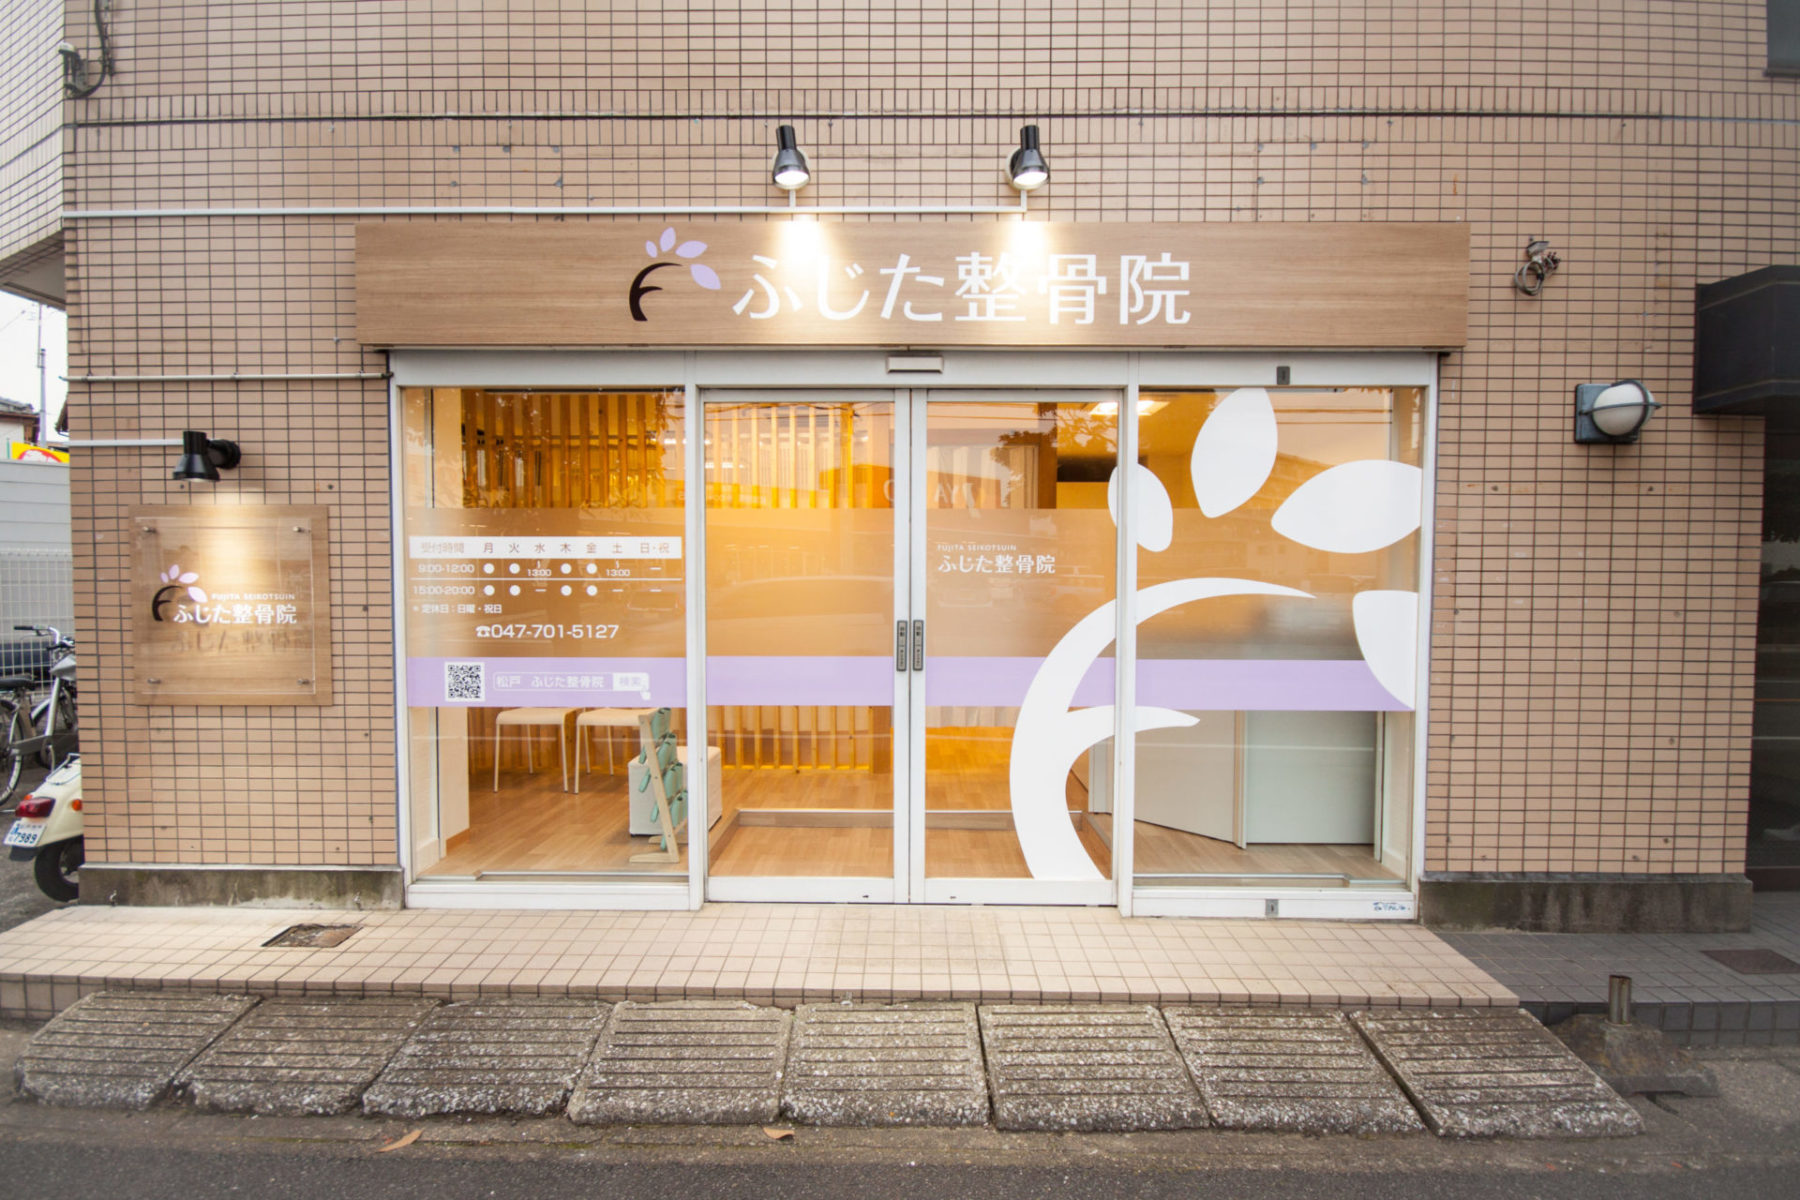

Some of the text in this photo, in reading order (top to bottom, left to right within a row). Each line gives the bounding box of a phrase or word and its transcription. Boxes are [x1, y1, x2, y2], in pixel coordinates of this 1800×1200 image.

[733, 252, 1191, 325] ふじた整骨院
[483, 542, 494, 554] 月
[509, 542, 520, 554] 火
[534, 542, 546, 554] 水
[560, 542, 572, 554] 木
[586, 542, 597, 554] 金
[612, 543, 623, 554] 土
[937, 554, 1056, 574] ふじた整骨院
[173, 603, 297, 625] ふじた整骨院
[490, 624, 620, 639] 047-701-5127
[496, 675, 521, 688] 松戸
[531, 675, 605, 688] ふじた整骨院
